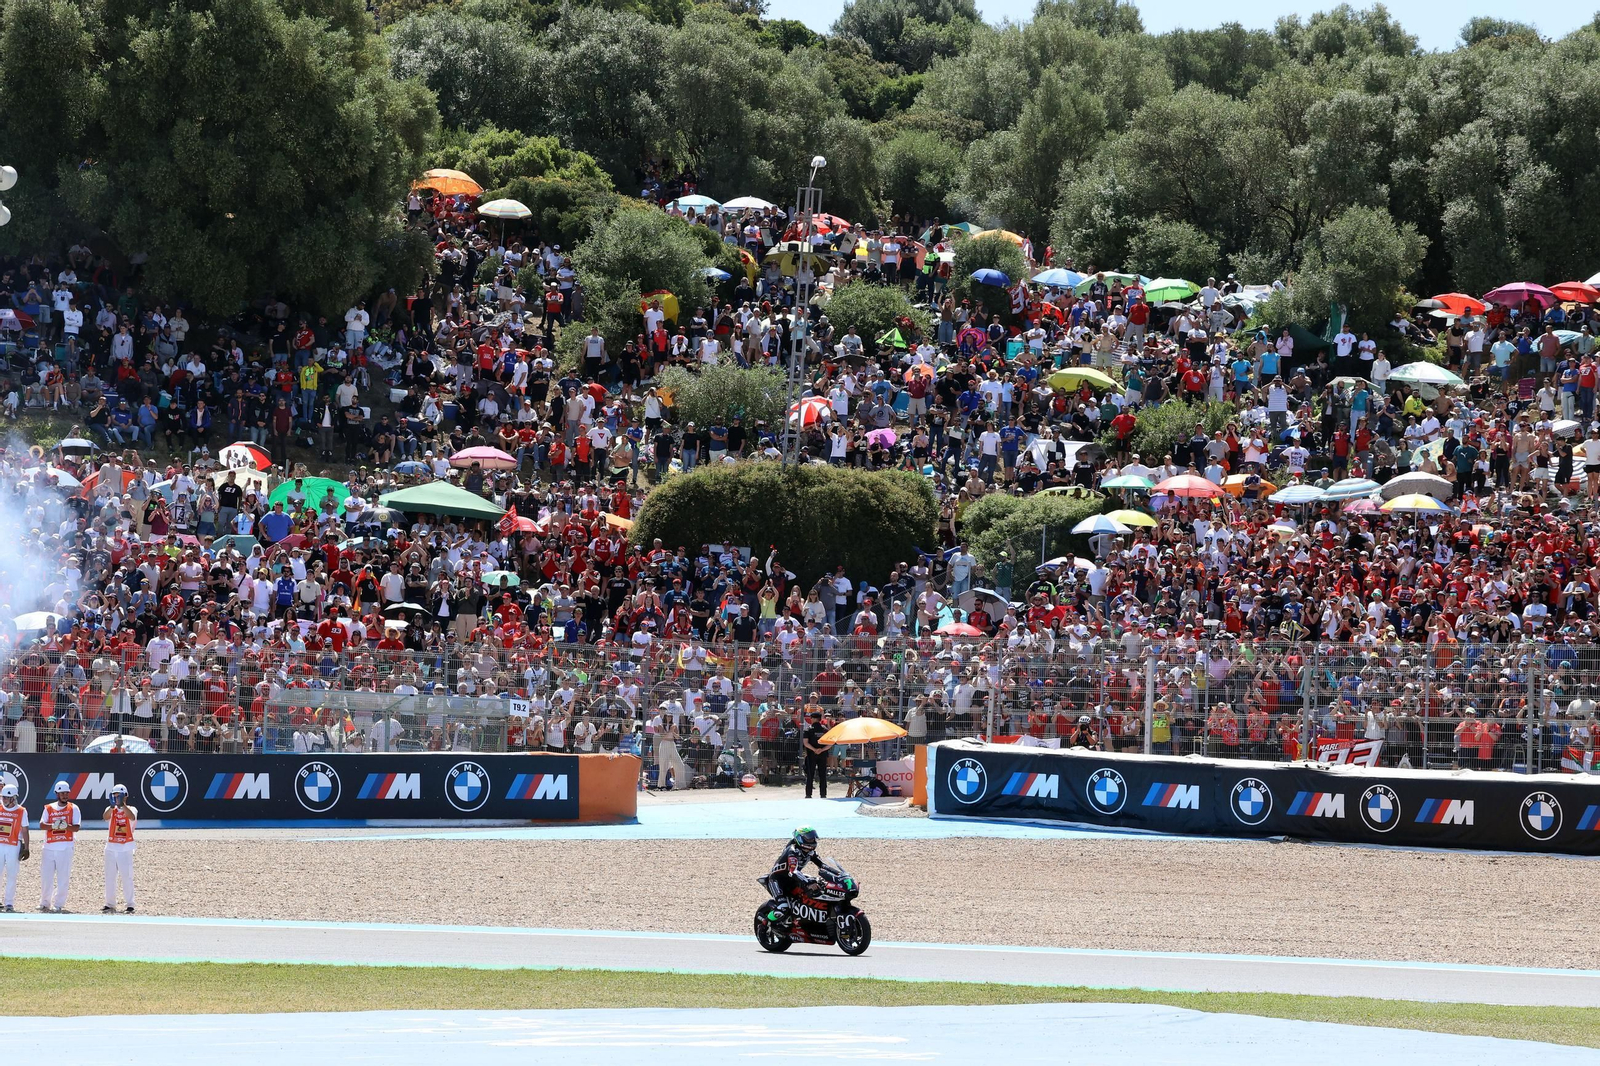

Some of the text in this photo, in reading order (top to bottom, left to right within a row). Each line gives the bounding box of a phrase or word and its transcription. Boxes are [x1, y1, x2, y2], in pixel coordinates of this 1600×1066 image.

[513, 702, 527, 712] T9.2
[148, 763, 182, 778] BMW
[300, 764, 335, 778] BMW
[451, 764, 484, 778] BMW
[954, 760, 983, 774] BMW
[876, 772, 914, 782] DOCTO
[1093, 770, 1122, 784] BMW
[1236, 780, 1267, 794] BMW
[1365, 786, 1395, 801] BMW
[1525, 794, 1557, 808] BMW
[792, 903, 828, 923] SONE
